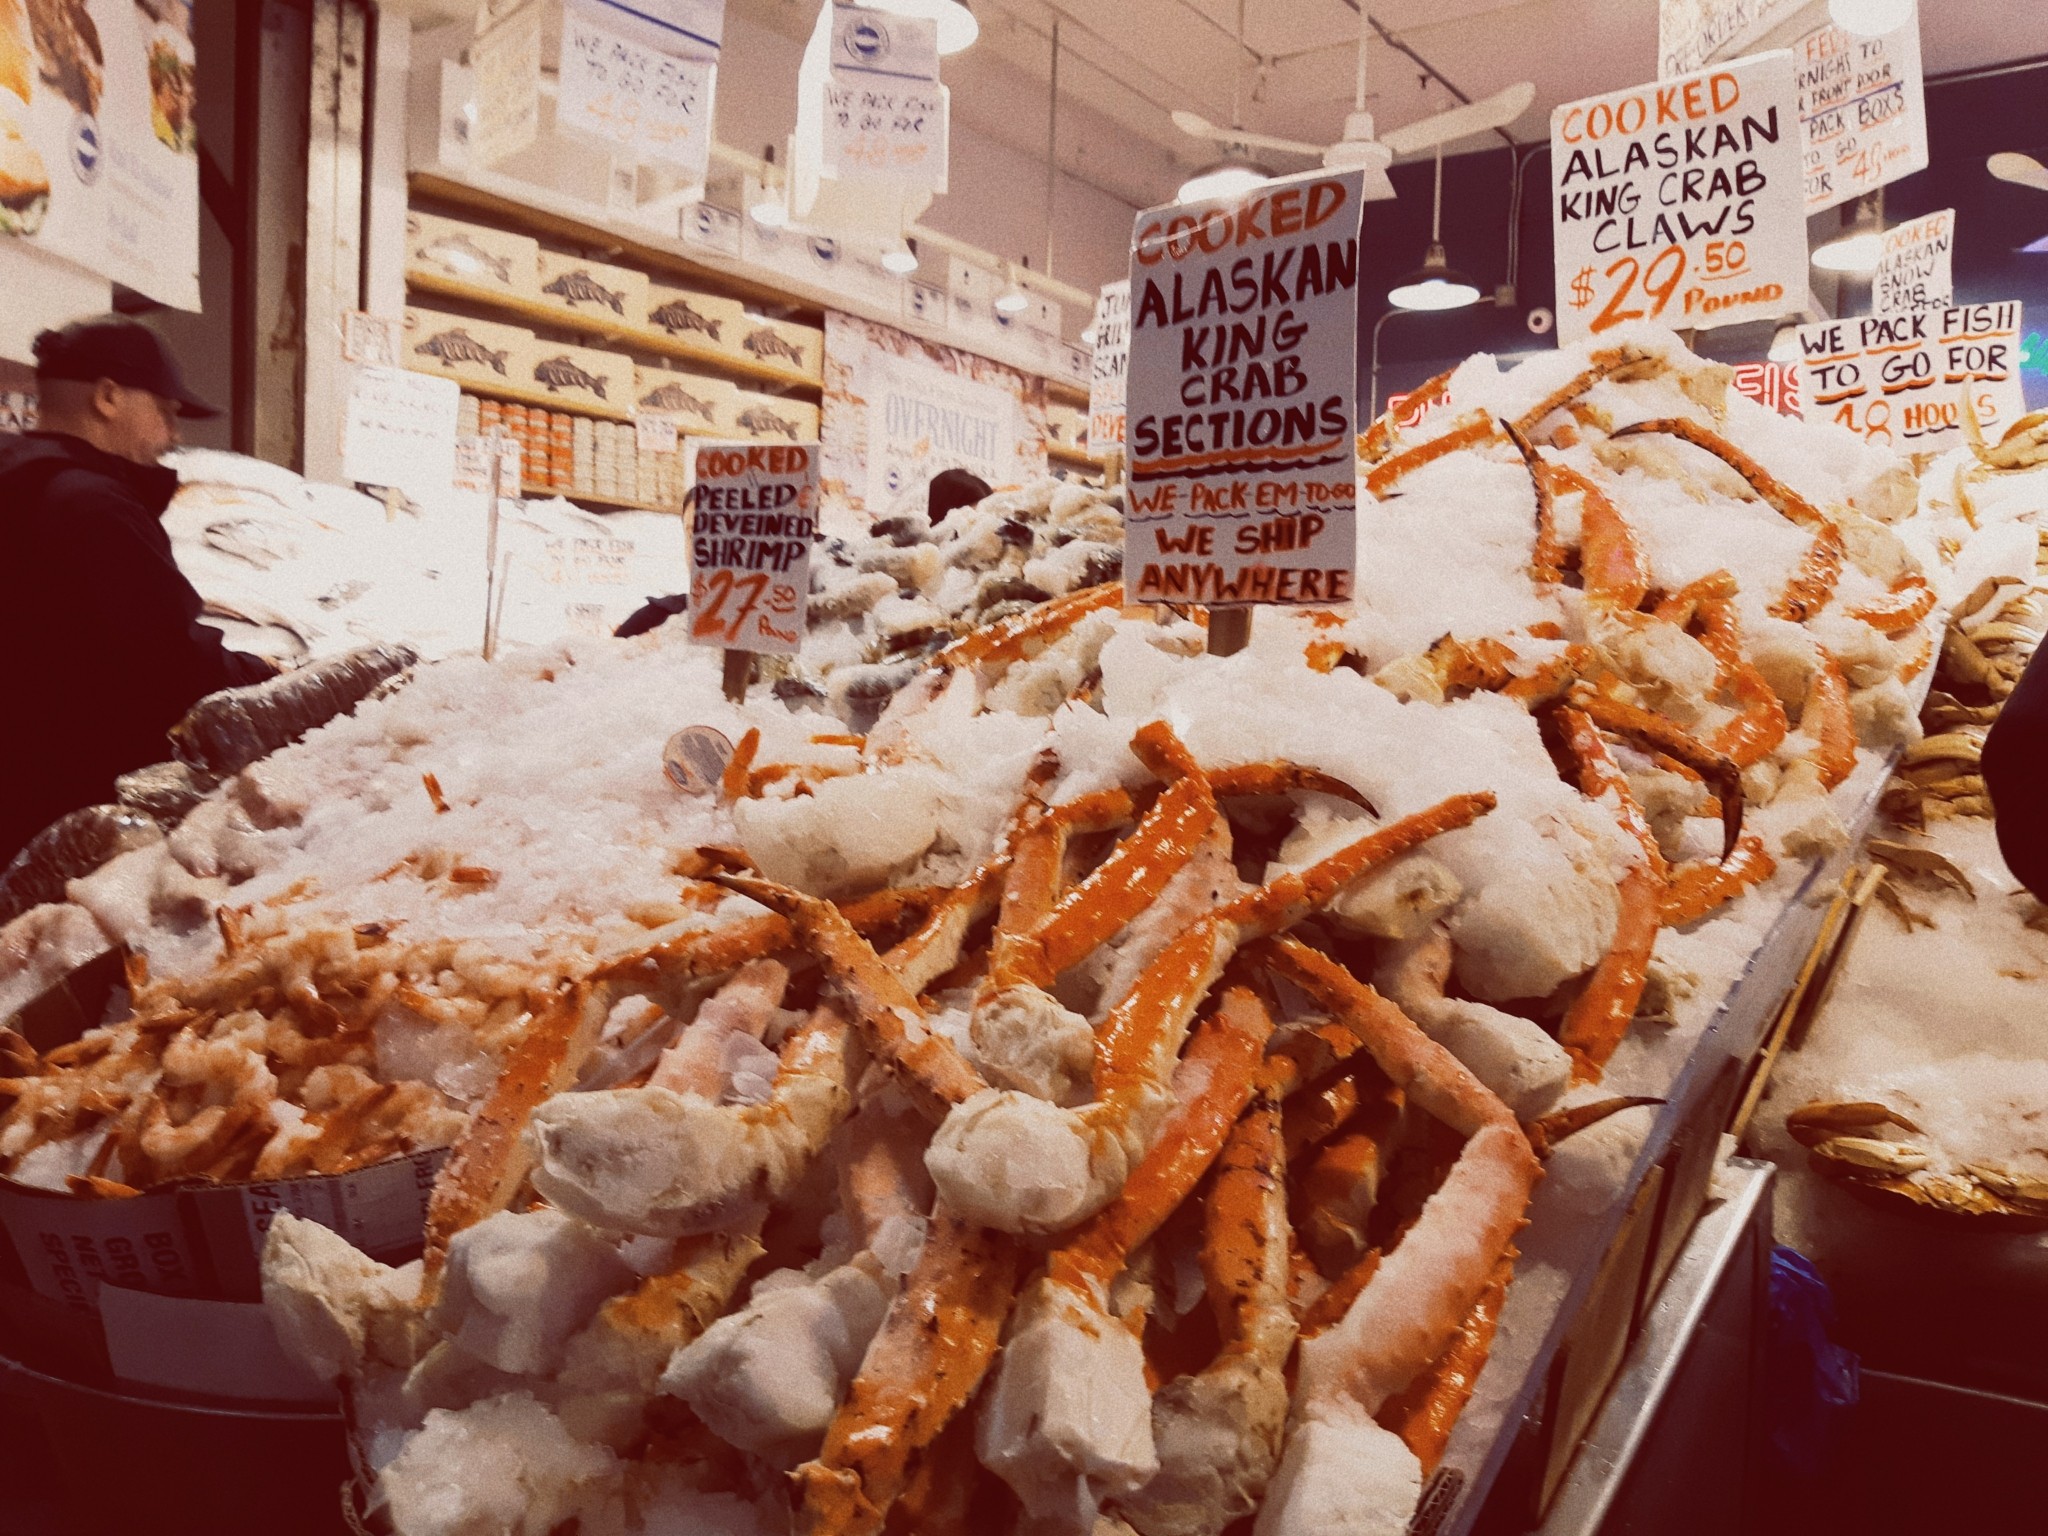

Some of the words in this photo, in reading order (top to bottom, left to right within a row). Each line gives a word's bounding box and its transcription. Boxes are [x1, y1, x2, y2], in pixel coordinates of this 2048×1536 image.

[1859, 39, 1883, 59] TO
[1562, 72, 1740, 144] COOKED
[1561, 105, 1779, 187] ALASKAN
[1561, 181, 1641, 222] KING
[1659, 159, 1766, 205] CRAB
[1137, 180, 1347, 266] COOKED
[1593, 199, 1755, 253] CLAWS
[1136, 238, 1357, 329] ALASKAN
[1182, 310, 1308, 372] KING
[1800, 325, 1844, 355] WE
[1860, 314, 1926, 346] PACK
[1943, 303, 2014, 334] FISH
[1181, 354, 1308, 407] CRAB
[1811, 362, 1860, 390] TO
[1882, 351, 1931, 383] GO
[1948, 344, 2007, 372] FOR
[885, 393, 999, 461] OVERNIGHT
[1134, 395, 1348, 456] SECTIONS
[1903, 394, 1998, 429] HOUS
[696, 446, 809, 478] COOKED
[695, 484, 797, 511] PEELED
[693, 513, 813, 538] DEVEINED
[1155, 524, 1216, 556] WE
[1234, 513, 1325, 555] SHIP
[694, 537, 806, 572] SHRIMP
[1137, 561, 1350, 601] ANYWHERE
